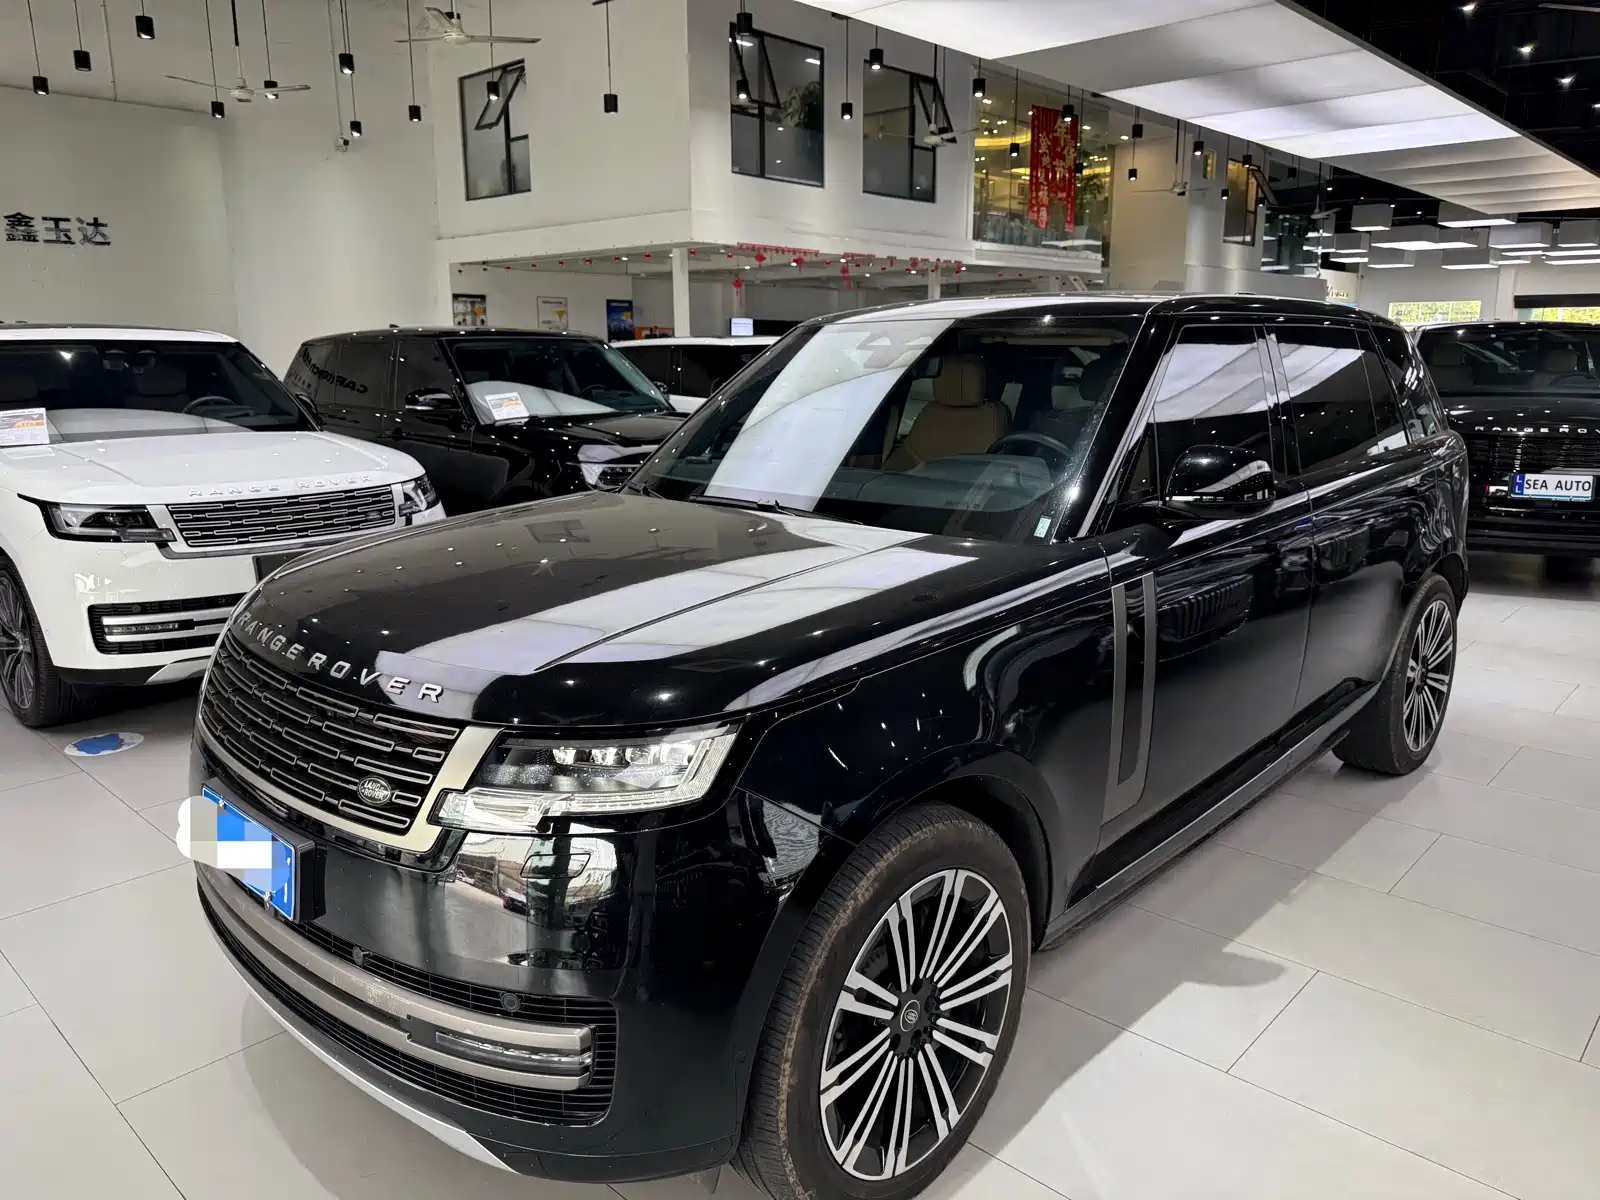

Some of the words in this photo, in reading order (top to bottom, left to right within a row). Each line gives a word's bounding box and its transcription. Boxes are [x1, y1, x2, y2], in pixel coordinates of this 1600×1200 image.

[3, 212, 111, 245] 鑫玉达
[188, 484, 280, 497] RANGE
[297, 474, 373, 489] ROVER
[1524, 479, 1548, 490] SEA
[1554, 480, 1592, 492] AUTO
[237, 611, 305, 660] RANGE
[307, 652, 444, 703] ROVER
[364, 780, 381, 790] LAND
[363, 789, 385, 800] ROVER
